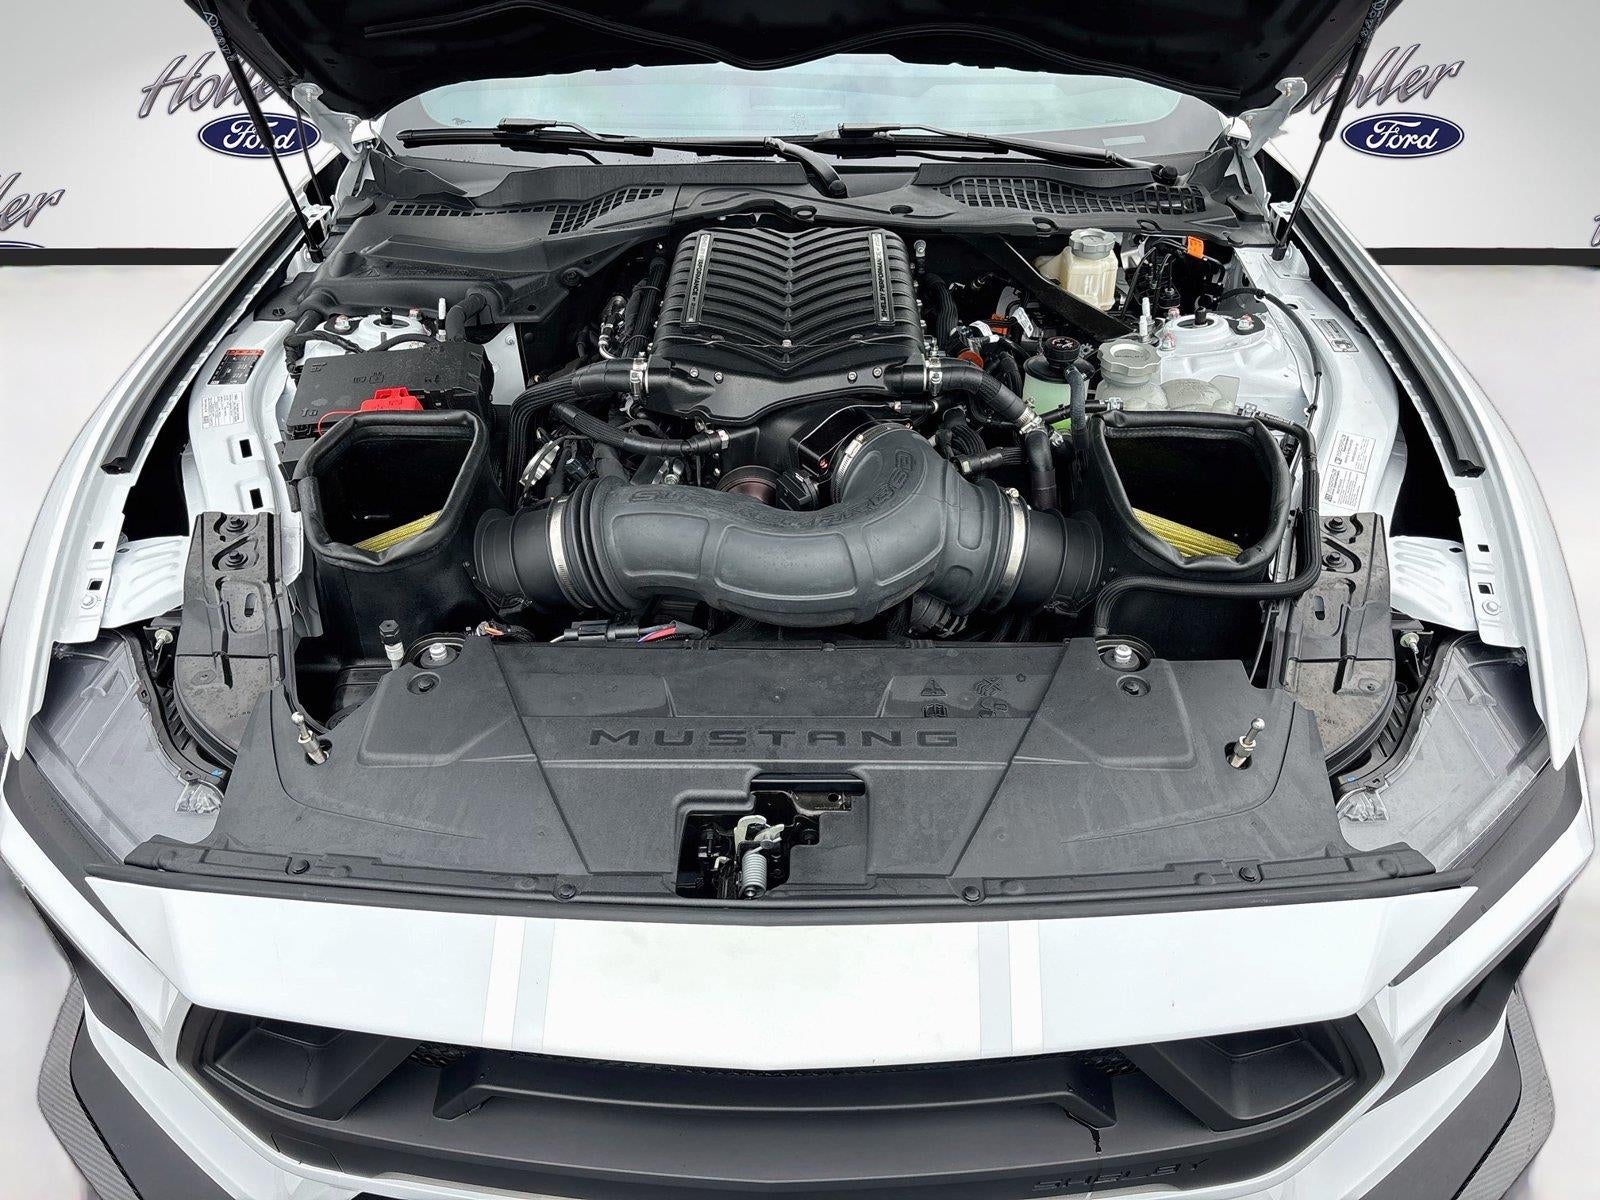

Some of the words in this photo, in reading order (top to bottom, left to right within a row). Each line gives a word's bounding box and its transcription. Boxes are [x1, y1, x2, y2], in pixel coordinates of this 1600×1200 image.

[1311, 43, 1465, 114] oller
[222, 119, 295, 149] Fod
[1365, 119, 1439, 149] Ford
[588, 728, 959, 748] MUSTANG
